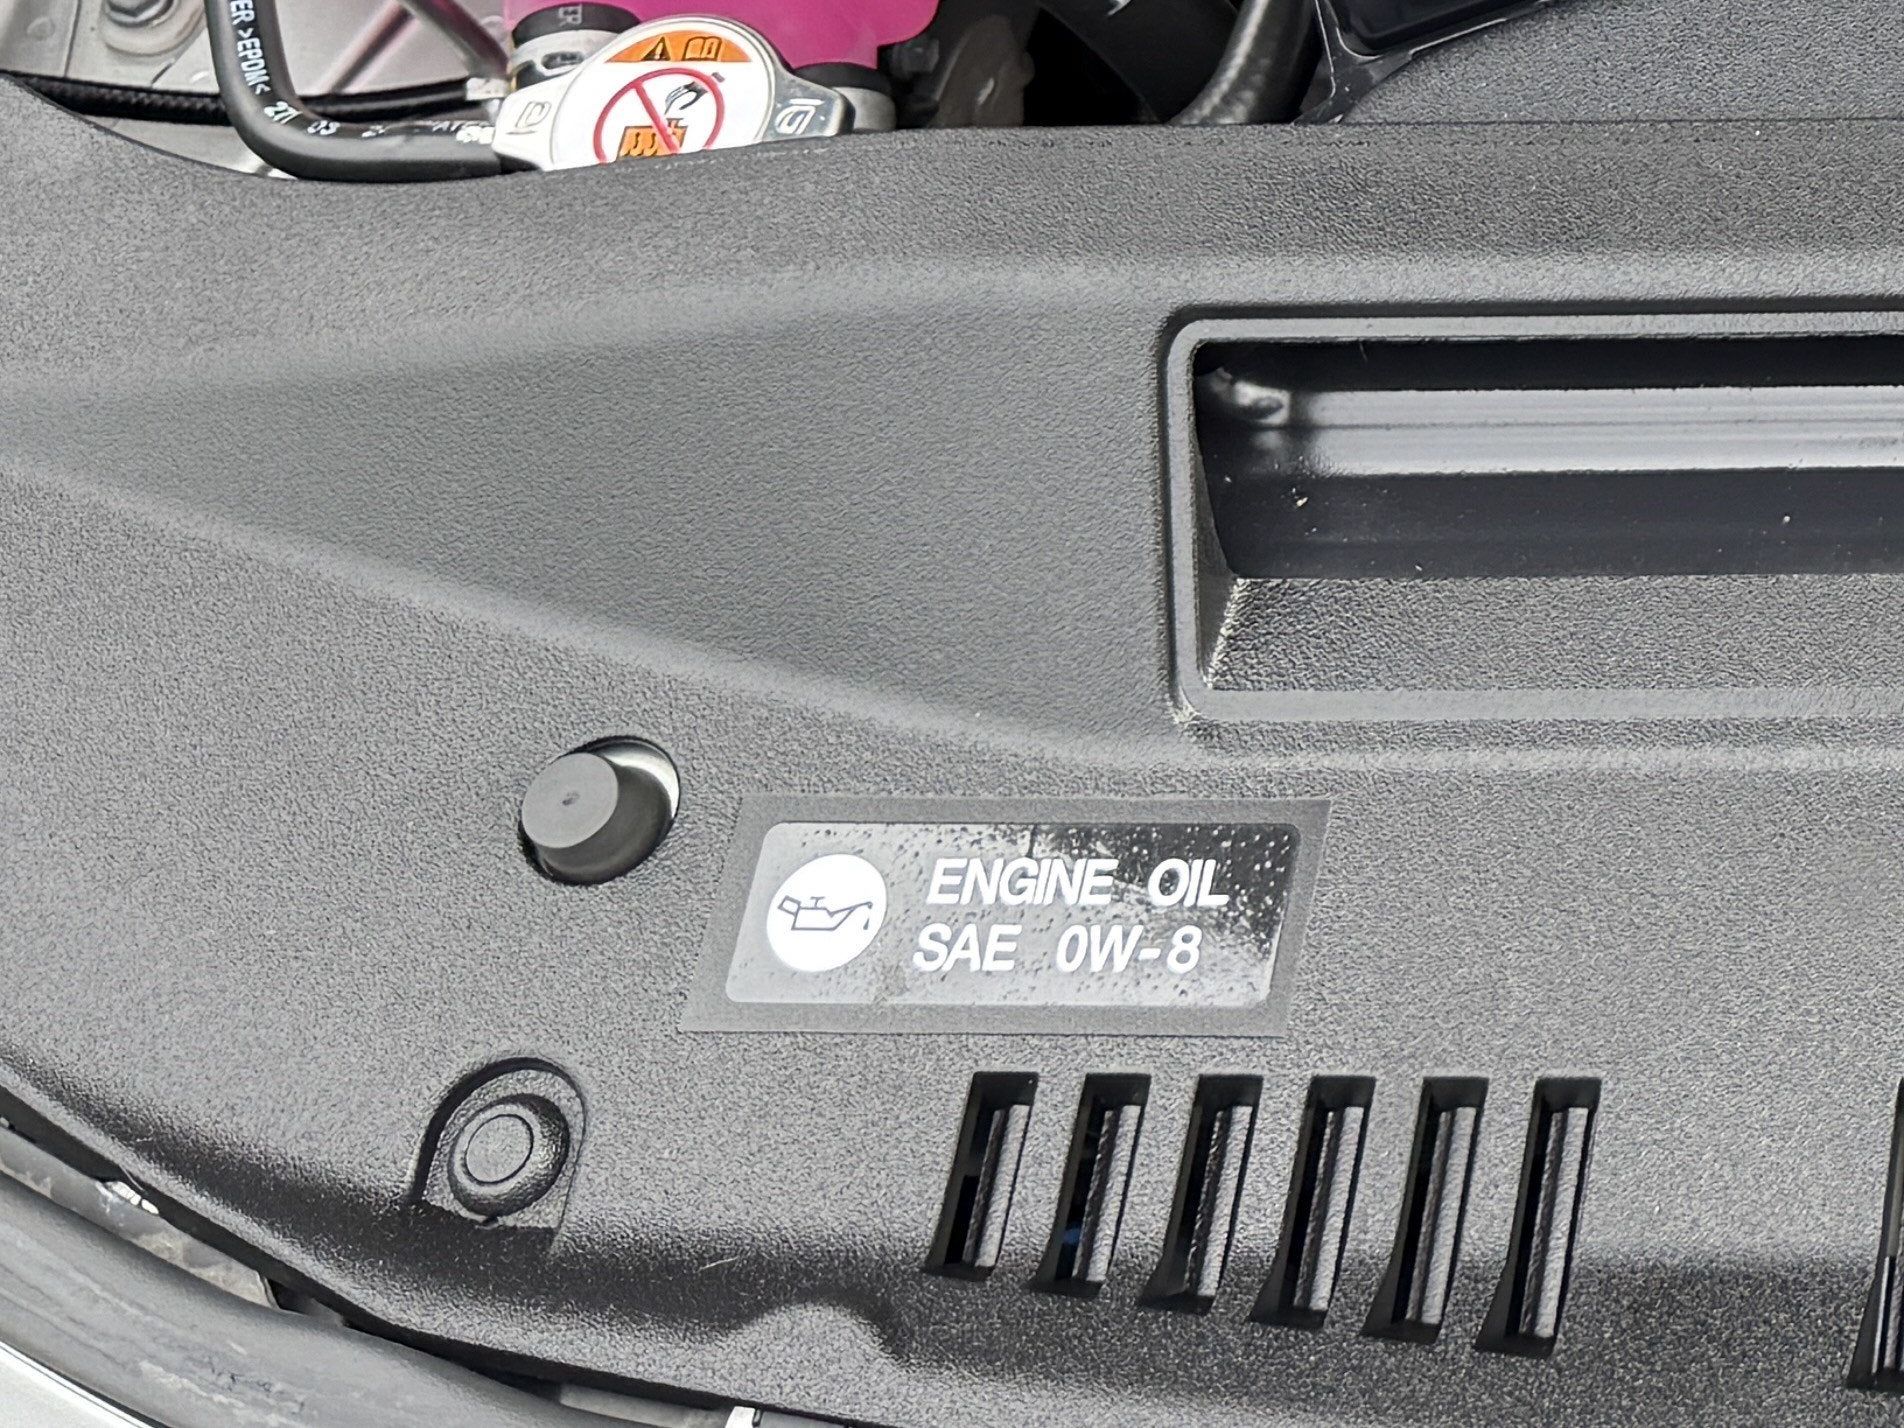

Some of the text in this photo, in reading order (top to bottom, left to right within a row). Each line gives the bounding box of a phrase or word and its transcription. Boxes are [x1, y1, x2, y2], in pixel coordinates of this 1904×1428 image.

[926, 855, 1231, 911] ENGINE OIL
[911, 922, 1203, 974] SAE 0W-8
